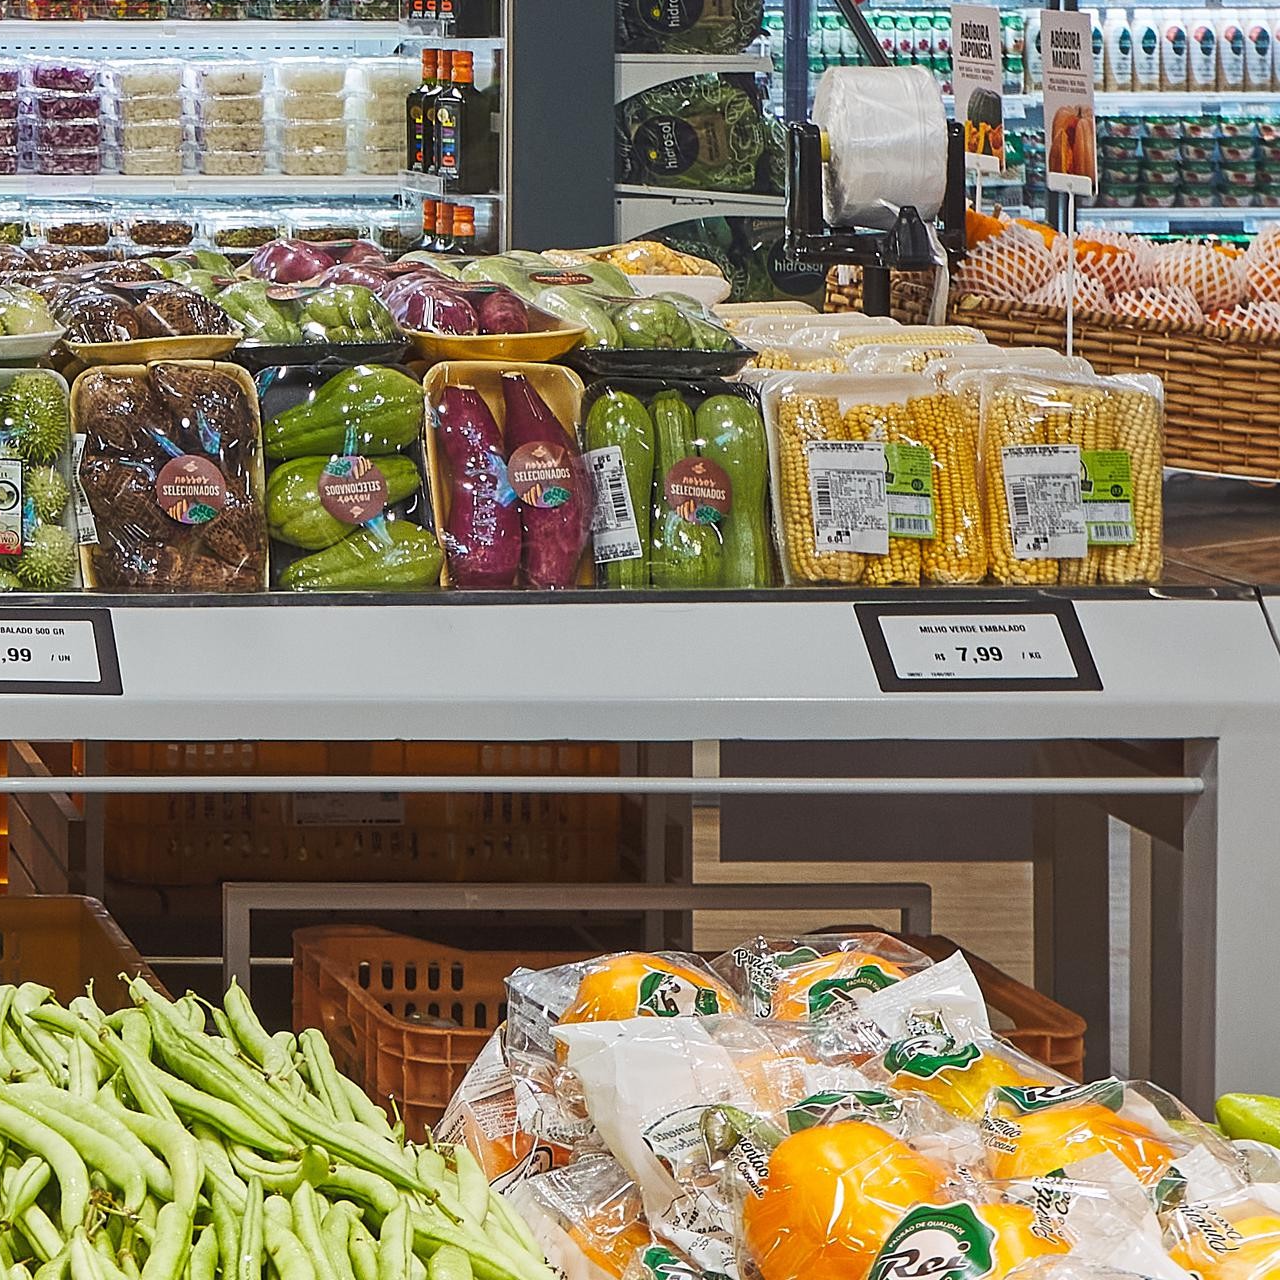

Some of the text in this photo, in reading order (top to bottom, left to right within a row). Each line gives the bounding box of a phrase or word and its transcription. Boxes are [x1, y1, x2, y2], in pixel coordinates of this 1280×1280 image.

[960, 20, 990, 42] ABÓBORA
[1050, 27, 1081, 51] ABÓBORA
[959, 41, 993, 61] JAPONESA
[1051, 51, 1081, 70] MADURA
[514, 467, 571, 483] SELECIONADOS
[162, 485, 220, 497] SELECIONADOS
[324, 480, 382, 497] SELECIONADOS
[670, 483, 726, 500] SELECIONADOS
[35, 627, 50, 635] 500
[52, 627, 65, 636] GR
[919, 624, 1026, 633] MILHO VERDE EMBALADO
[58, 653, 71, 662] UN
[934, 646, 1042, 664] R$ 7,99 KG
[888, 1220, 966, 1249] PADRÃO DE QUALIDADE
